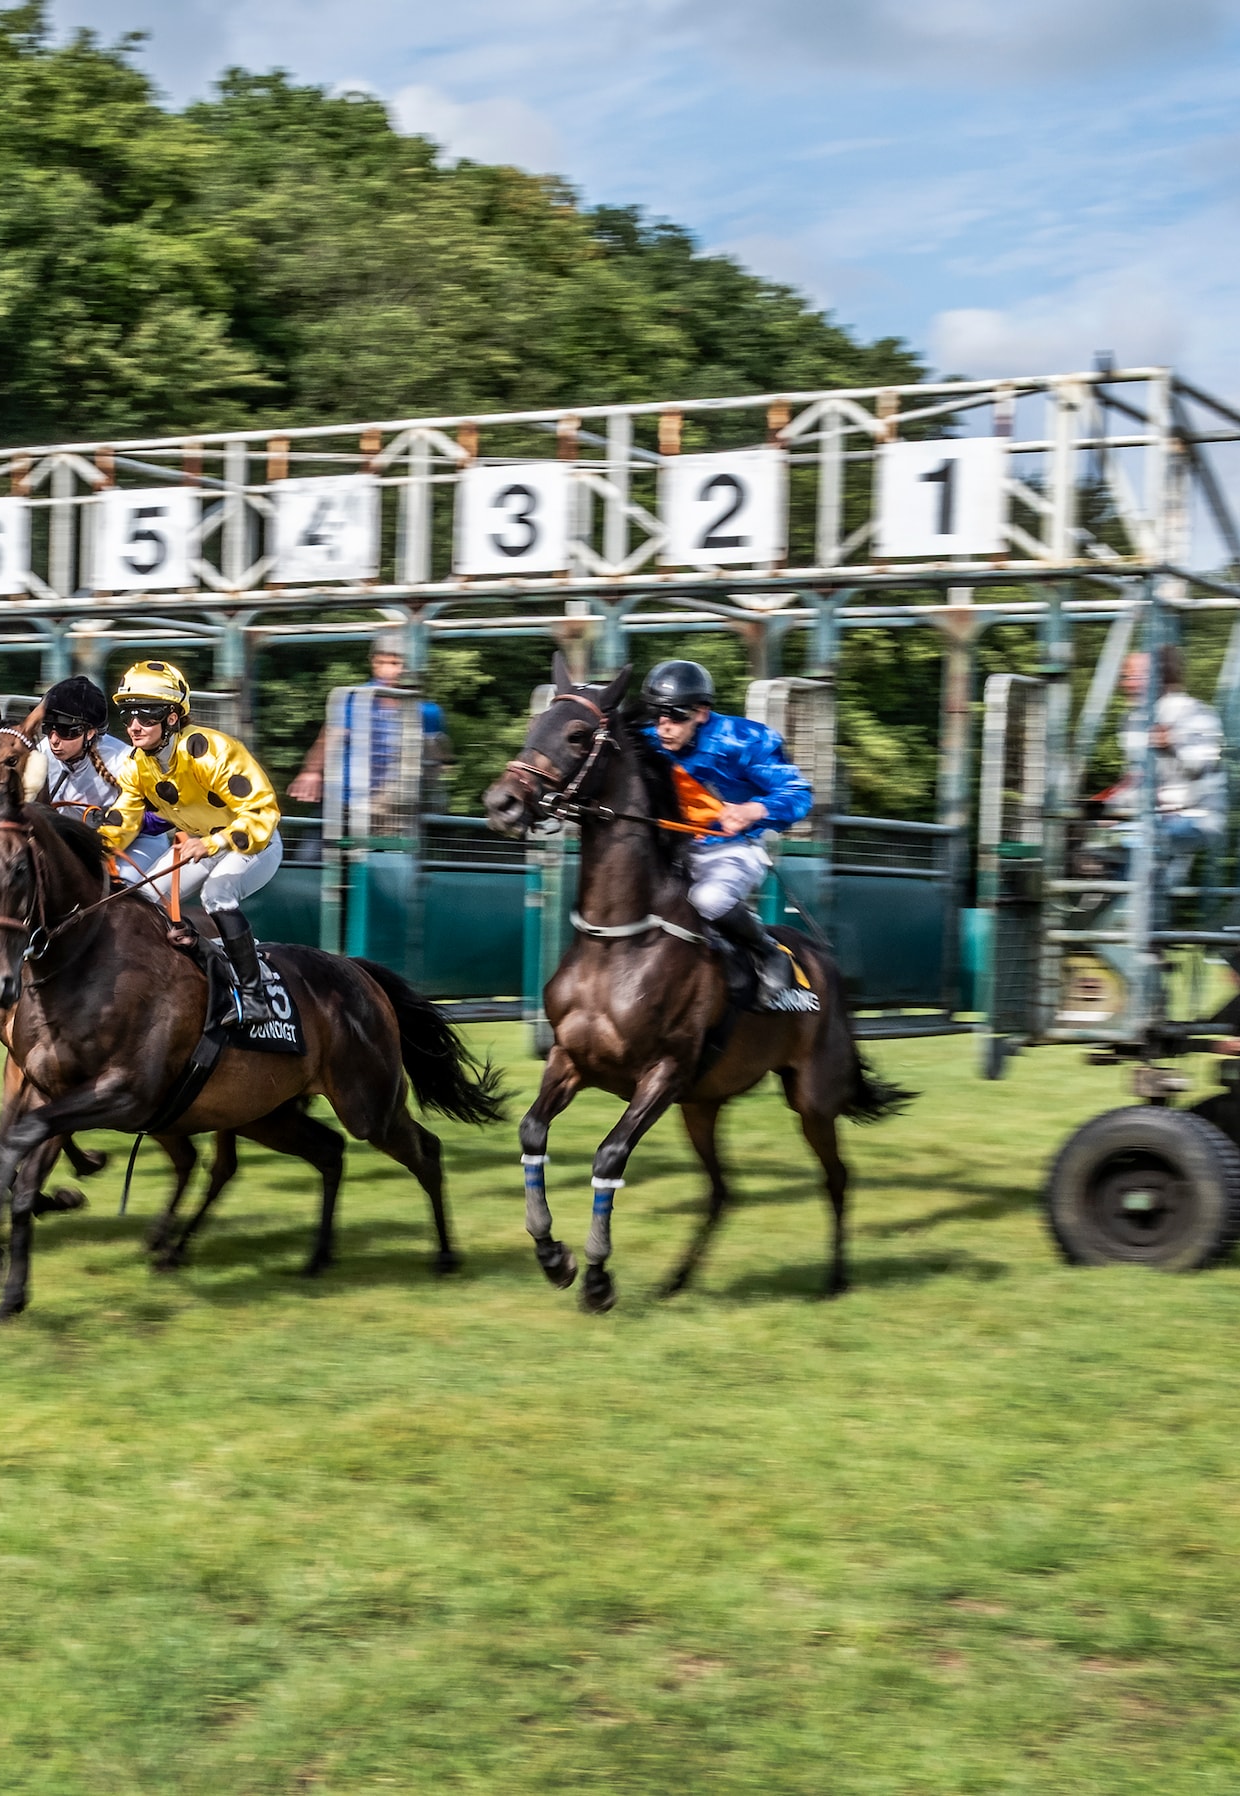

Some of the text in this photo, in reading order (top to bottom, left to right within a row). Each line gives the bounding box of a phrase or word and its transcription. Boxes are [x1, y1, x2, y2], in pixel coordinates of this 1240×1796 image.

[489, 483, 540, 558] 3
[694, 473, 750, 550] 2
[918, 457, 959, 536] 1
[122, 506, 168, 576] 5
[265, 971, 292, 1020] 5
